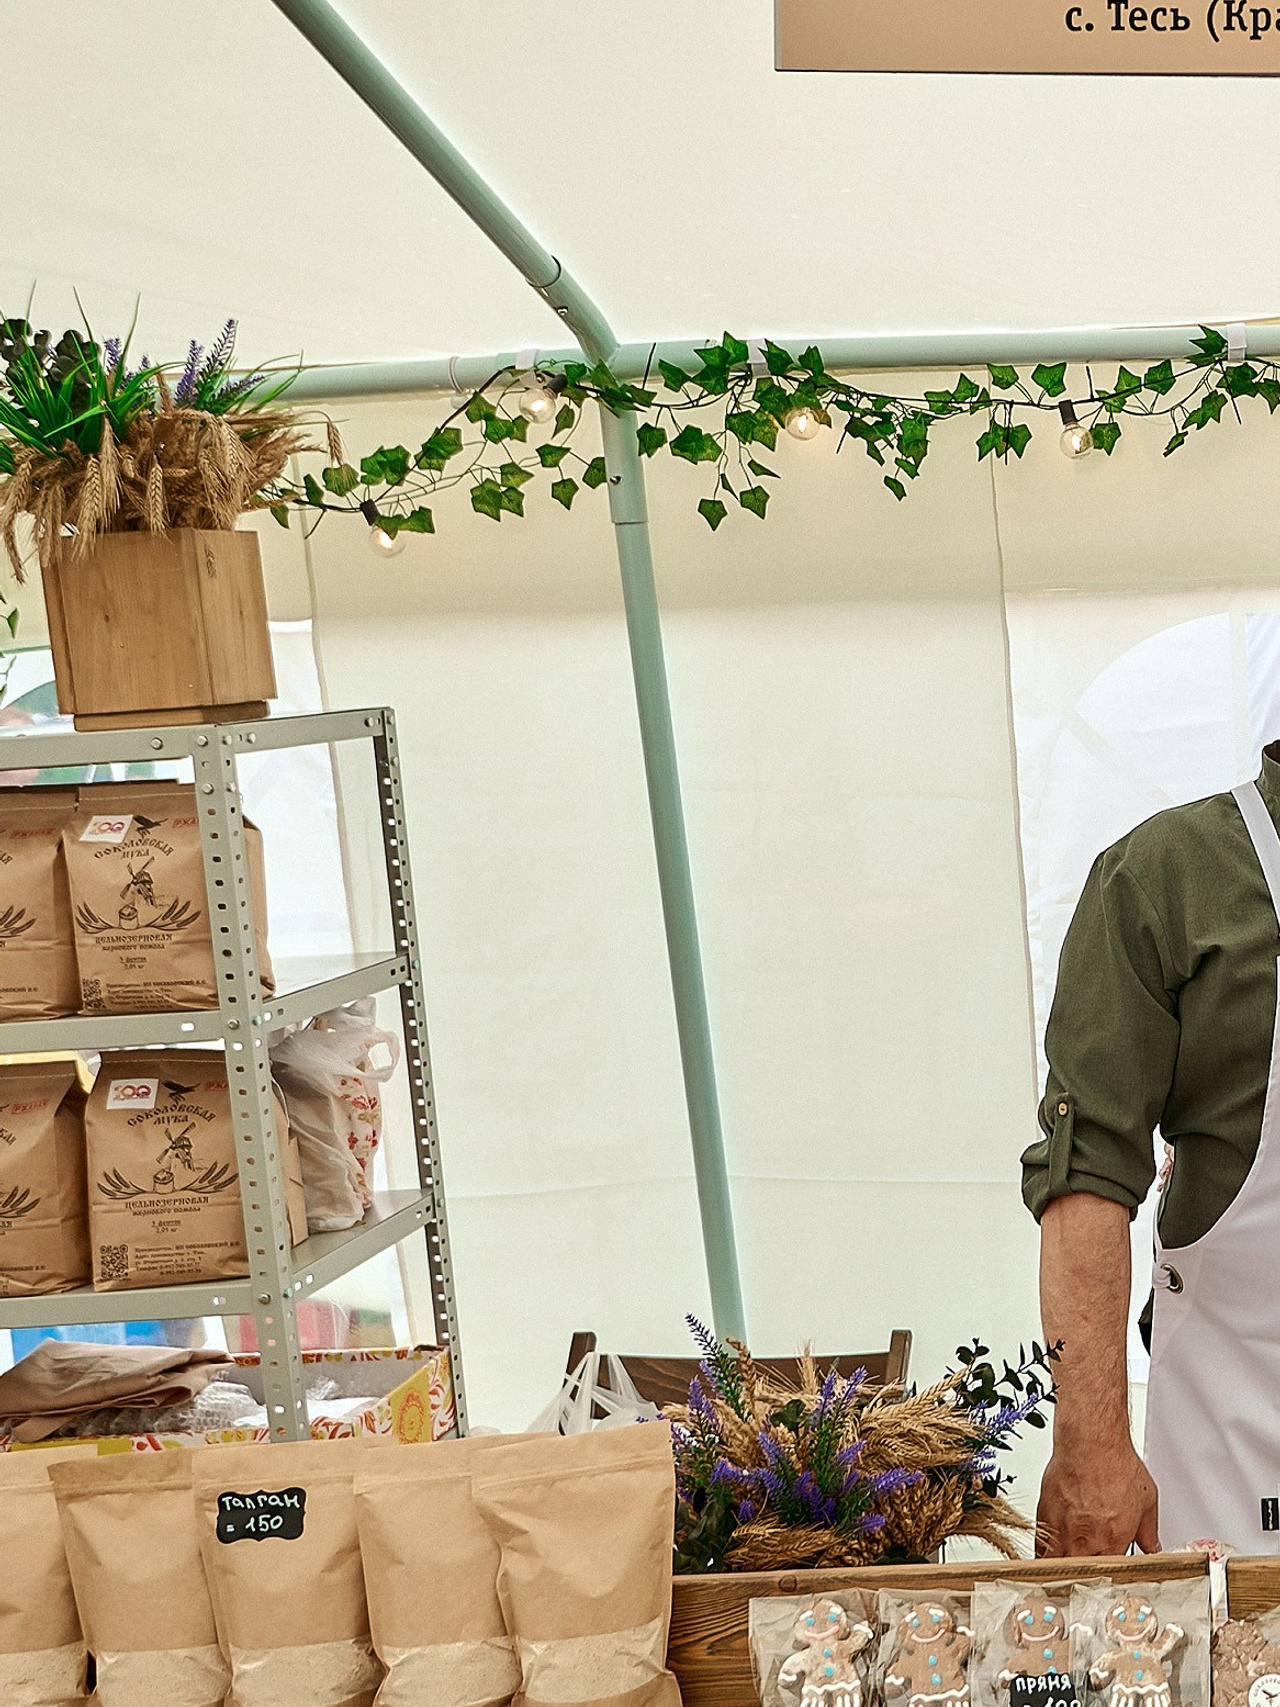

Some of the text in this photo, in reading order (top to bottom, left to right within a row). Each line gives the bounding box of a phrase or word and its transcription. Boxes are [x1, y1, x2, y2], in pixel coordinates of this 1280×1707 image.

[1064, 6, 1095, 32] с.
[1107, 0, 1191, 32] Тесь
[119, 849, 150, 860] МУКА
[127, 1104, 217, 1128] СОКОЛОВСКАЯ
[153, 1114, 189, 1125] МУКА
[125, 1196, 209, 1209] ЦЕЛЬНОЗЕРНОВАЯ
[245, 1514, 283, 1532] 150
